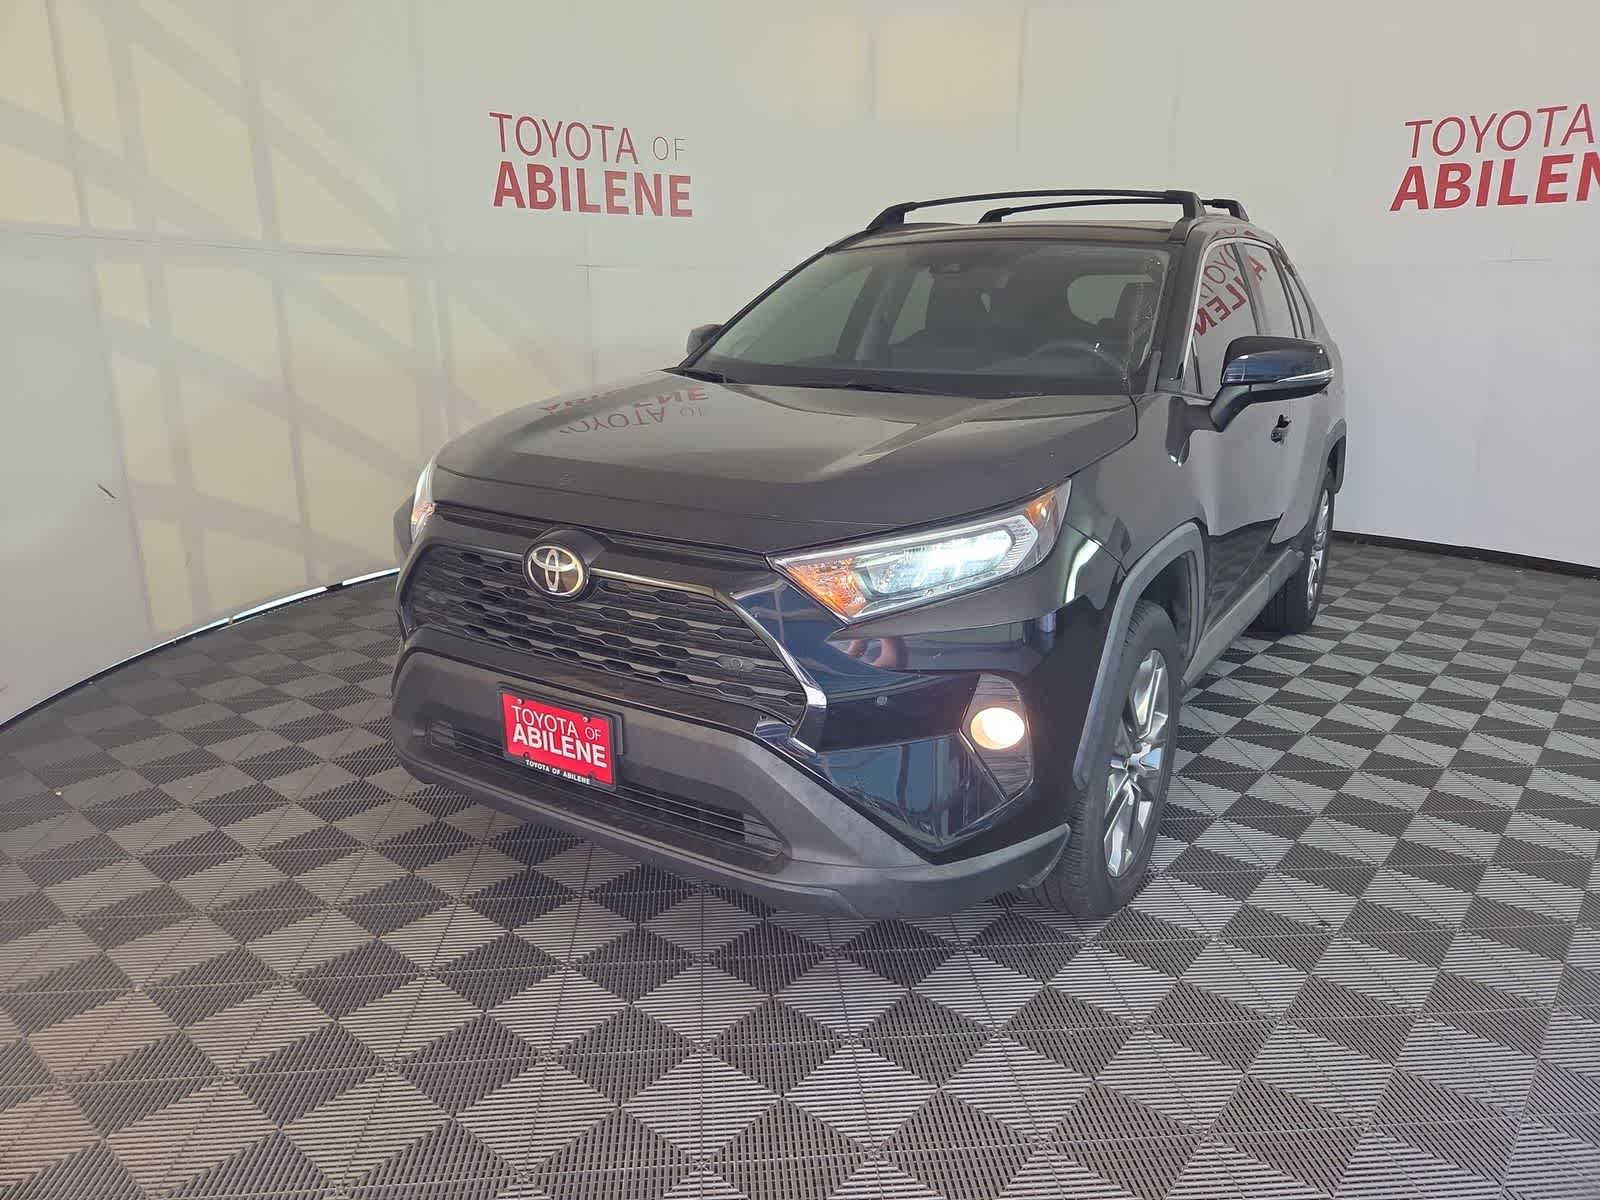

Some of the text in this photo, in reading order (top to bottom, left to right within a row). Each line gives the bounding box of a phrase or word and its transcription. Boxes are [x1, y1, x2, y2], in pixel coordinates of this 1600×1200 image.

[489, 112, 688, 164] TOYOTA OF
[1404, 103, 1595, 158] TOYOTA
[493, 160, 693, 218] ABILENE
[511, 705, 602, 741] TOYOTA OF
[512, 723, 608, 769] ABILENE
[525, 759, 591, 785] TOYOTA OF ABILENE
